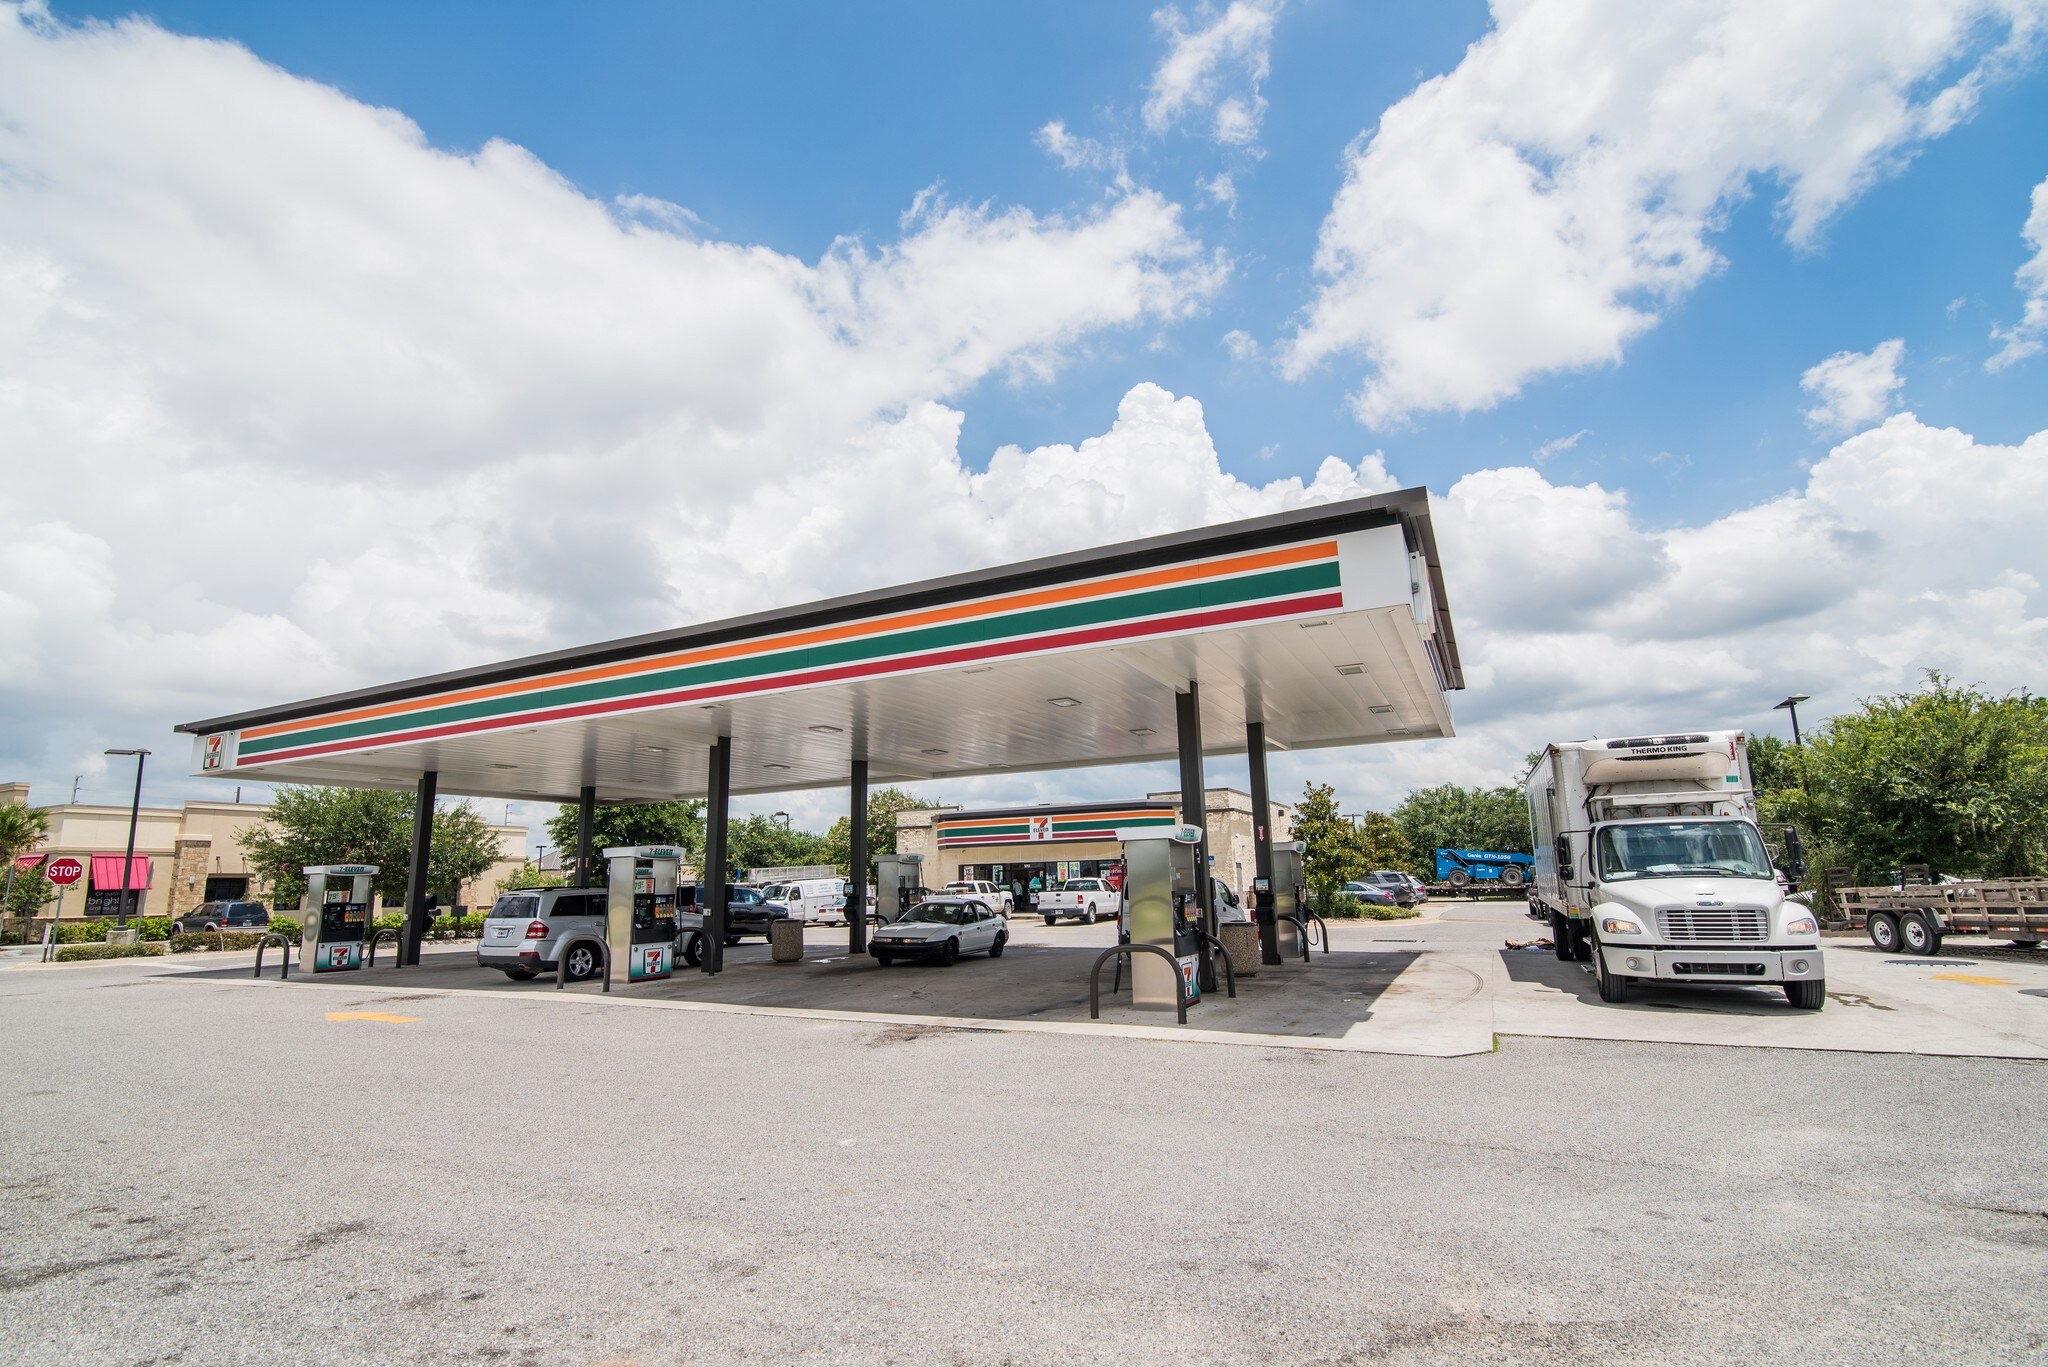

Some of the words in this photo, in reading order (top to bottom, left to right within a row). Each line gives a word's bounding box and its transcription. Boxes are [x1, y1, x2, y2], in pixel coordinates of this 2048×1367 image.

[208, 736, 221, 768] 7
[1631, 746, 1666, 755] THERMO
[1033, 817, 1048, 839] 7
[49, 866, 81, 877] STOP
[88, 897, 133, 907] brightr
[333, 948, 348, 965] 7
[647, 951, 660, 973] 7
